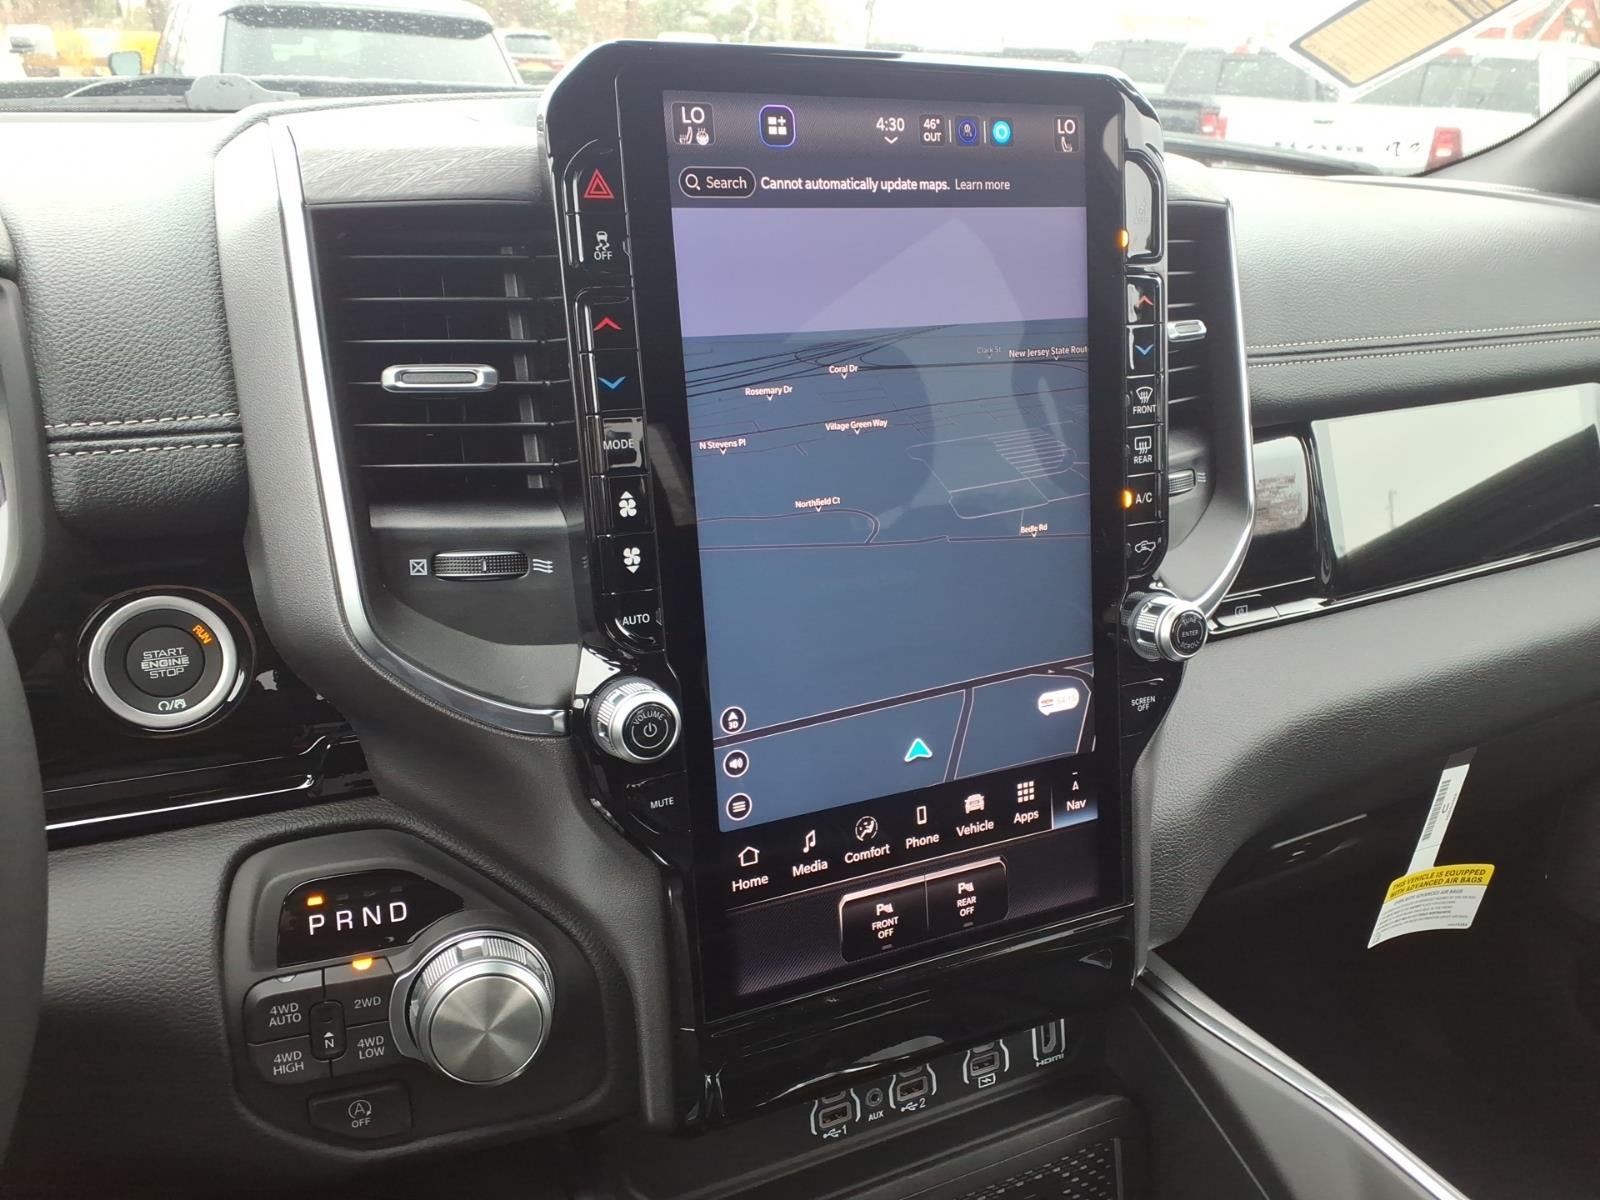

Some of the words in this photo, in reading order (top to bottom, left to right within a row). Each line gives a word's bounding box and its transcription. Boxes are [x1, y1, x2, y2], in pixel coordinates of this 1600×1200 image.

[681, 105, 706, 124] LO
[875, 117, 906, 132] 4:30
[923, 118, 941, 130] 46°
[1057, 118, 1077, 135] LO
[923, 131, 943, 143] OUT
[705, 175, 748, 190] Search
[760, 177, 803, 191] Cannot
[804, 177, 879, 193] automatically
[880, 178, 918, 193] update
[919, 179, 951, 193] maps.
[954, 178, 983, 191] Learn
[984, 180, 1011, 191] more
[594, 251, 612, 261] OFF
[1008, 349, 1026, 358] New
[1027, 347, 1050, 358] Jersey
[1051, 346, 1070, 355] State
[1070, 345, 1088, 354] Rout
[828, 365, 848, 374] Coral
[849, 364, 858, 373] Dr
[745, 387, 782, 397] Rosemary
[783, 385, 793, 394] Dr
[1132, 404, 1157, 415] FRONT
[825, 422, 849, 431] Village
[850, 420, 872, 429] Green
[872, 419, 888, 428] Way
[603, 438, 635, 450] MODE
[699, 441, 706, 450] N
[707, 440, 738, 449] Stevens
[738, 438, 746, 447] Pl
[1133, 455, 1153, 464] REAR
[795, 497, 831, 509] Northfield
[832, 496, 840, 504] Ct
[1135, 491, 1153, 504] A/C
[621, 613, 651, 626] AUTO
[193, 625, 212, 644] RUN
[1181, 629, 1199, 638] ENTER
[143, 647, 184, 660] START
[141, 656, 190, 670] ENGINE
[150, 667, 184, 679] STOP
[1131, 695, 1156, 706] SCREEN
[1137, 703, 1150, 712] OFF
[633, 710, 665, 726] VOLUME
[728, 720, 739, 730] 3D
[650, 796, 675, 809] MUTE
[1066, 800, 1086, 812] Nav
[1013, 811, 1039, 825] Apps
[956, 819, 994, 837] Vehicle
[905, 832, 940, 850] Phone
[844, 843, 891, 864] Comfort
[791, 859, 829, 878] Media
[1445, 868, 1486, 877] EQUIPPED
[731, 872, 770, 893] Home
[1459, 876, 1483, 884] BAGS
[956, 896, 977, 908] REAR
[308, 914, 325, 935] P
[335, 910, 353, 932] R
[361, 905, 382, 928] N
[389, 901, 408, 923] D
[959, 906, 975, 917] OFF
[871, 916, 899, 931] FRONT
[877, 928, 894, 939] OFF
[269, 1001, 299, 1015] 4WD
[353, 996, 382, 1009] 2WD
[269, 1012, 302, 1027] AUTO
[324, 1037, 335, 1048] N
[356, 1034, 385, 1050] 4WD
[273, 1050, 302, 1065] 4WD
[358, 1046, 385, 1060] LOW
[272, 1061, 304, 1075] HIGH
[352, 1116, 372, 1128] OFF
[868, 1109, 884, 1122] AUX
